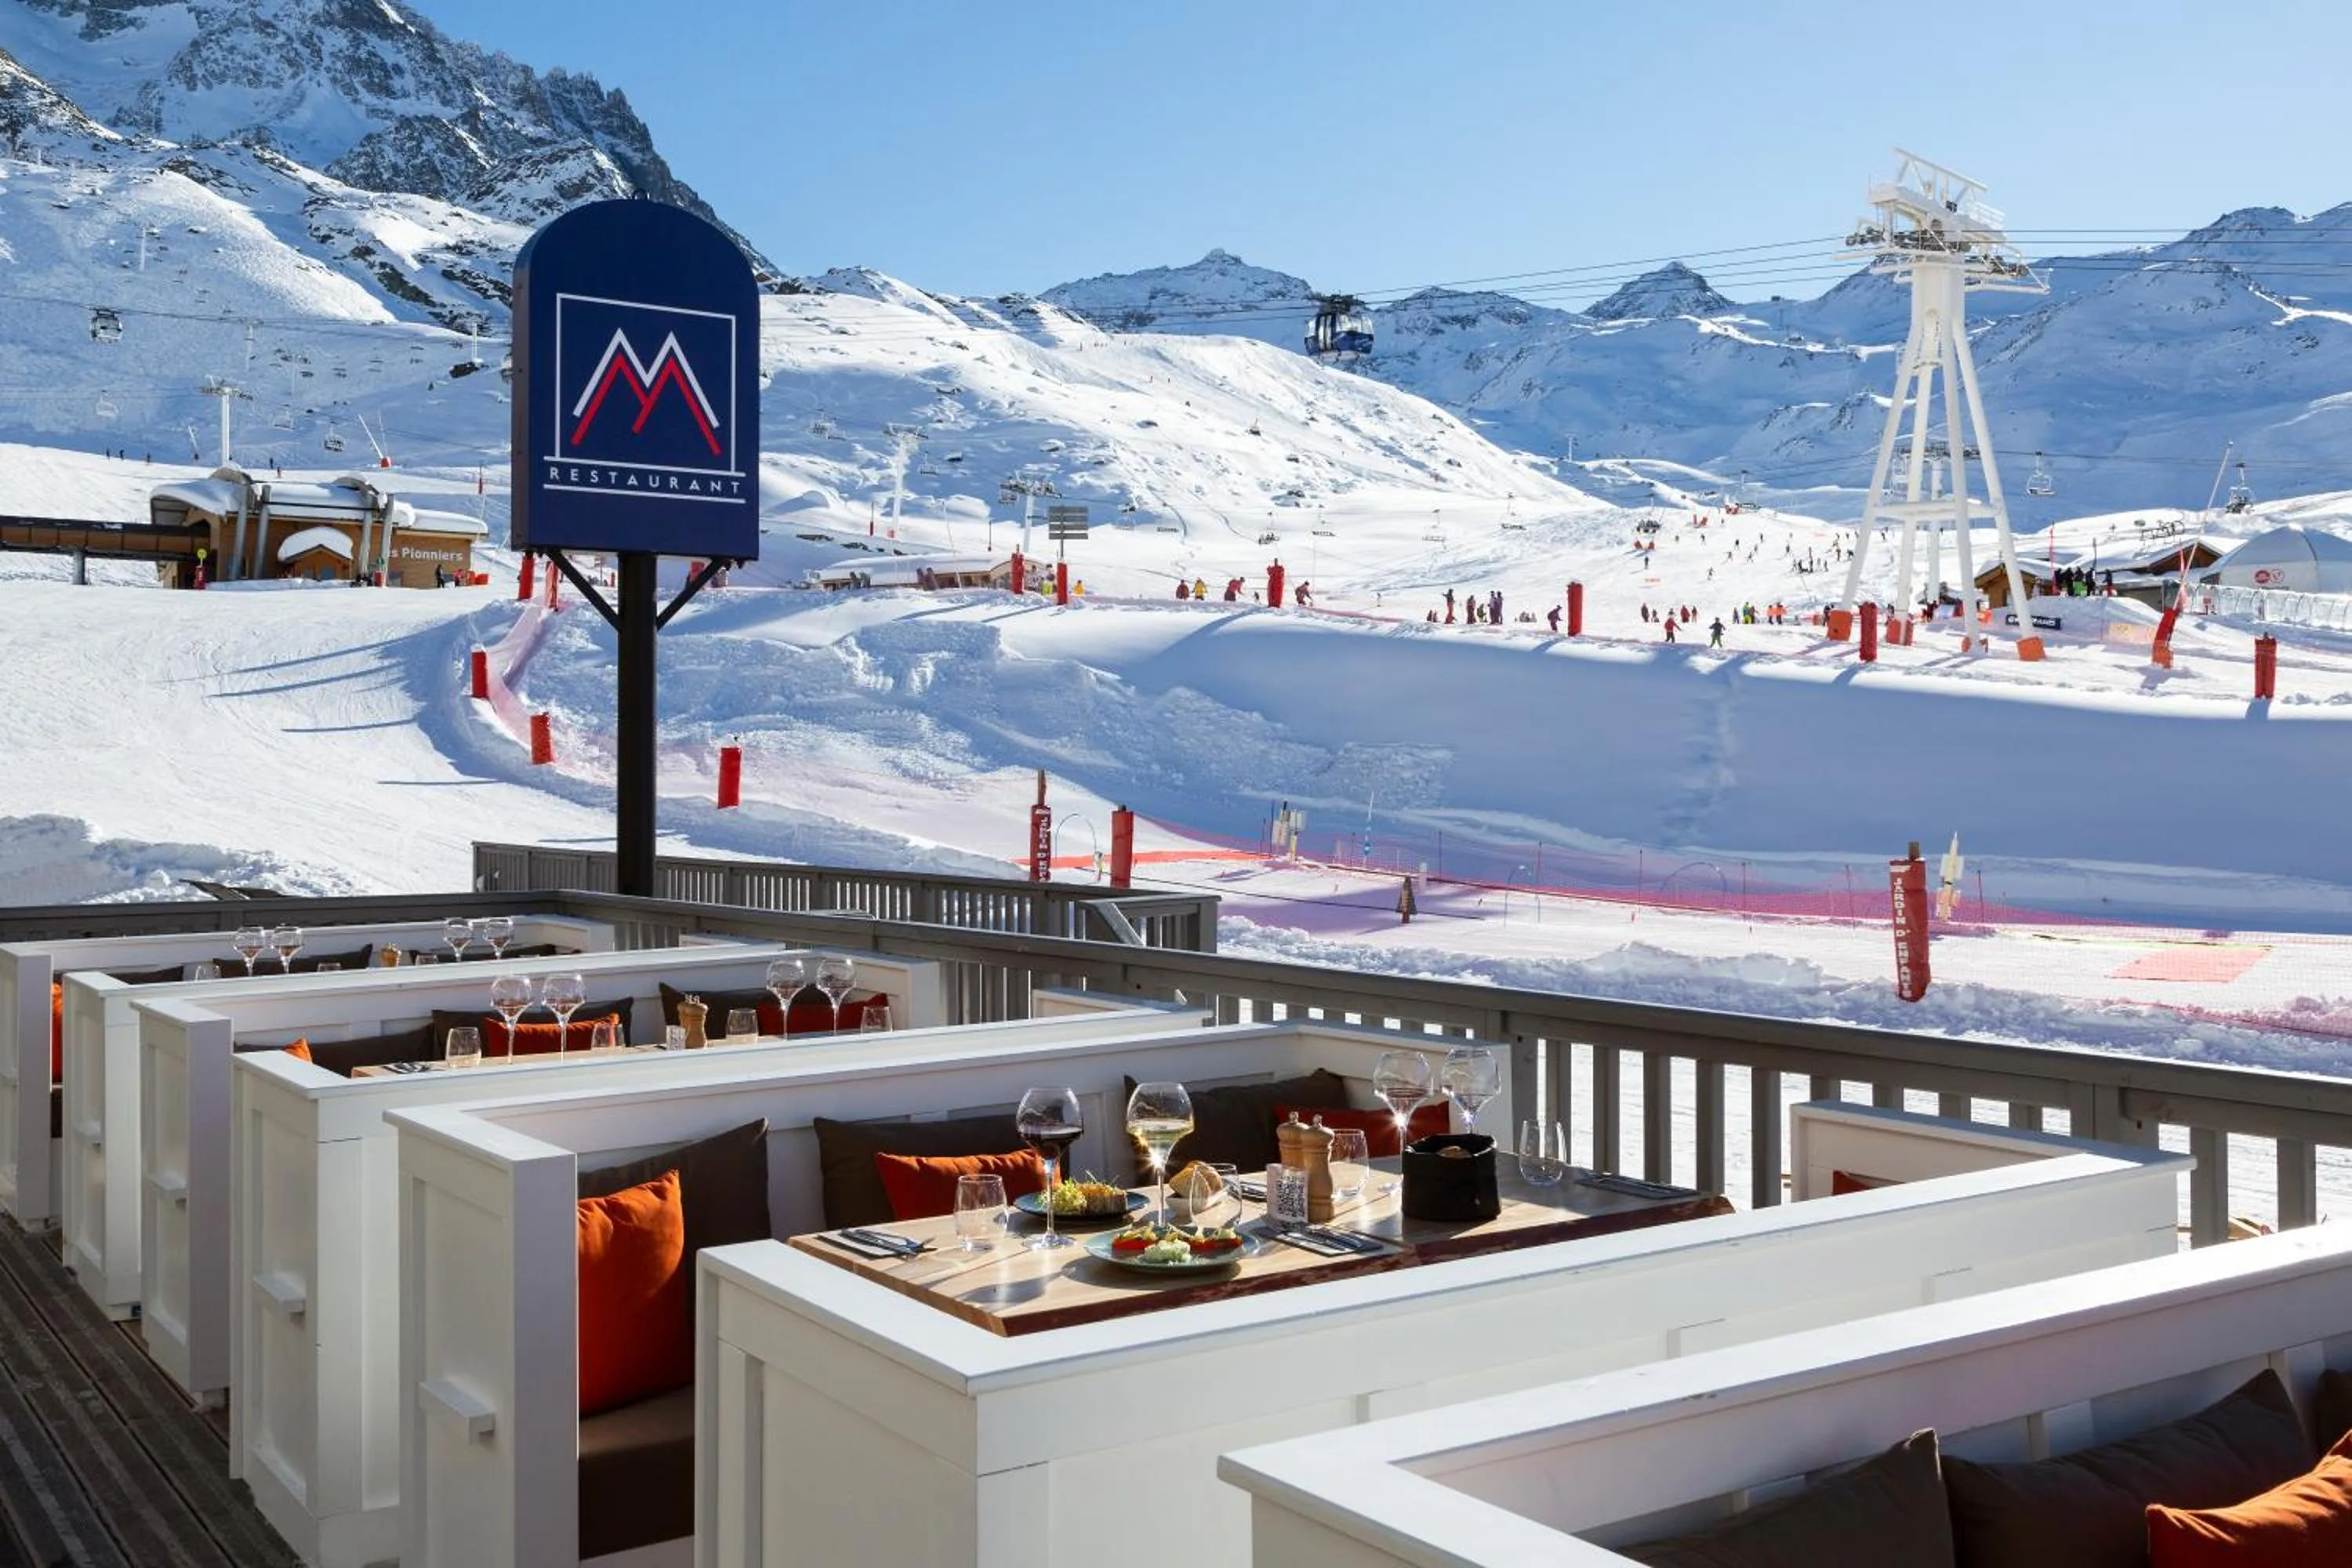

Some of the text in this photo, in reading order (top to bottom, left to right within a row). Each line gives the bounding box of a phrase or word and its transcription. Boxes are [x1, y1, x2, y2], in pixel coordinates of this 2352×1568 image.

[550, 466, 740, 494] RESTAURANT
[401, 546, 463, 562] Pionniers
[1893, 877, 1906, 924] JARDIN
